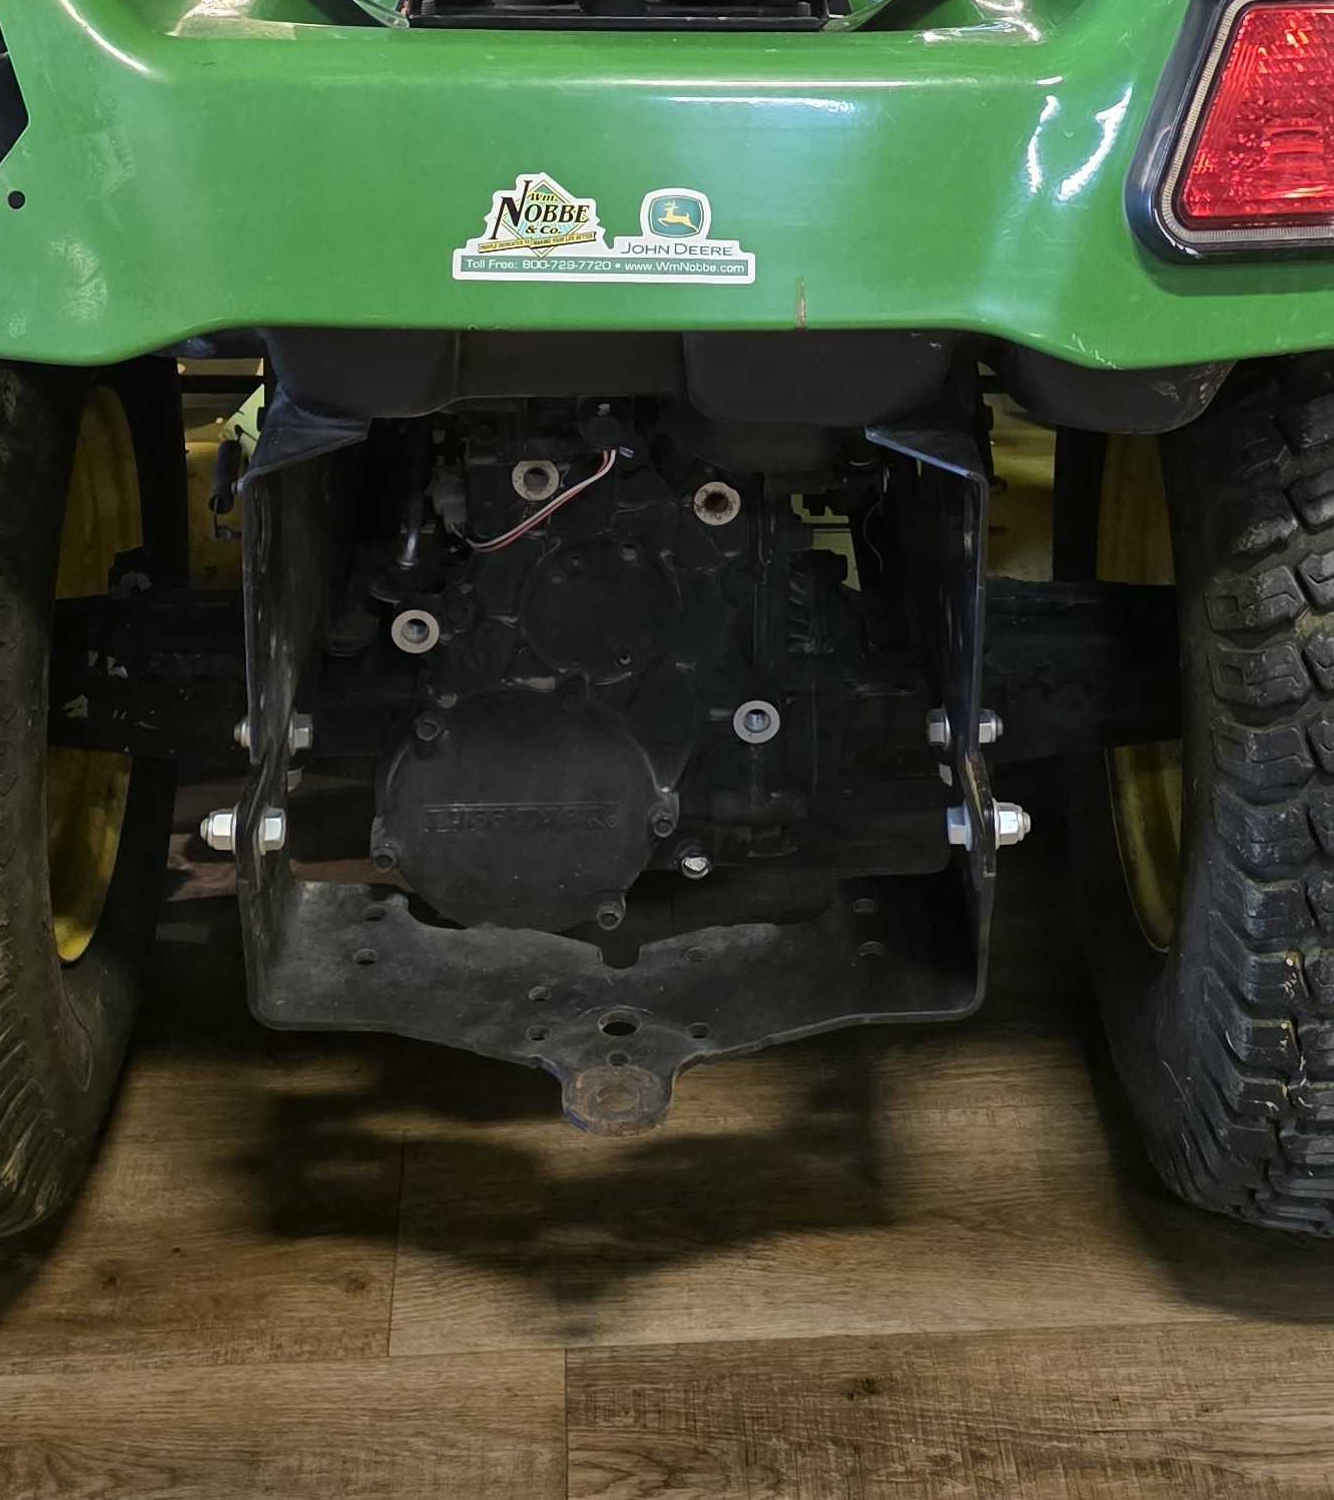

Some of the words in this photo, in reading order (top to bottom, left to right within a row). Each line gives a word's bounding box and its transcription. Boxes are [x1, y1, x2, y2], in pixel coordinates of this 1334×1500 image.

[529, 192, 558, 202] Wm.
[489, 180, 590, 240] NOBBE
[525, 226, 537, 234] &
[540, 225, 562, 235] Co.
[620, 242, 670, 255] JOHN
[674, 243, 733, 256] DEERE
[467, 259, 485, 269] Toll
[489, 259, 518, 269] Free:
[624, 261, 745, 273] www.WmNobbe.com
